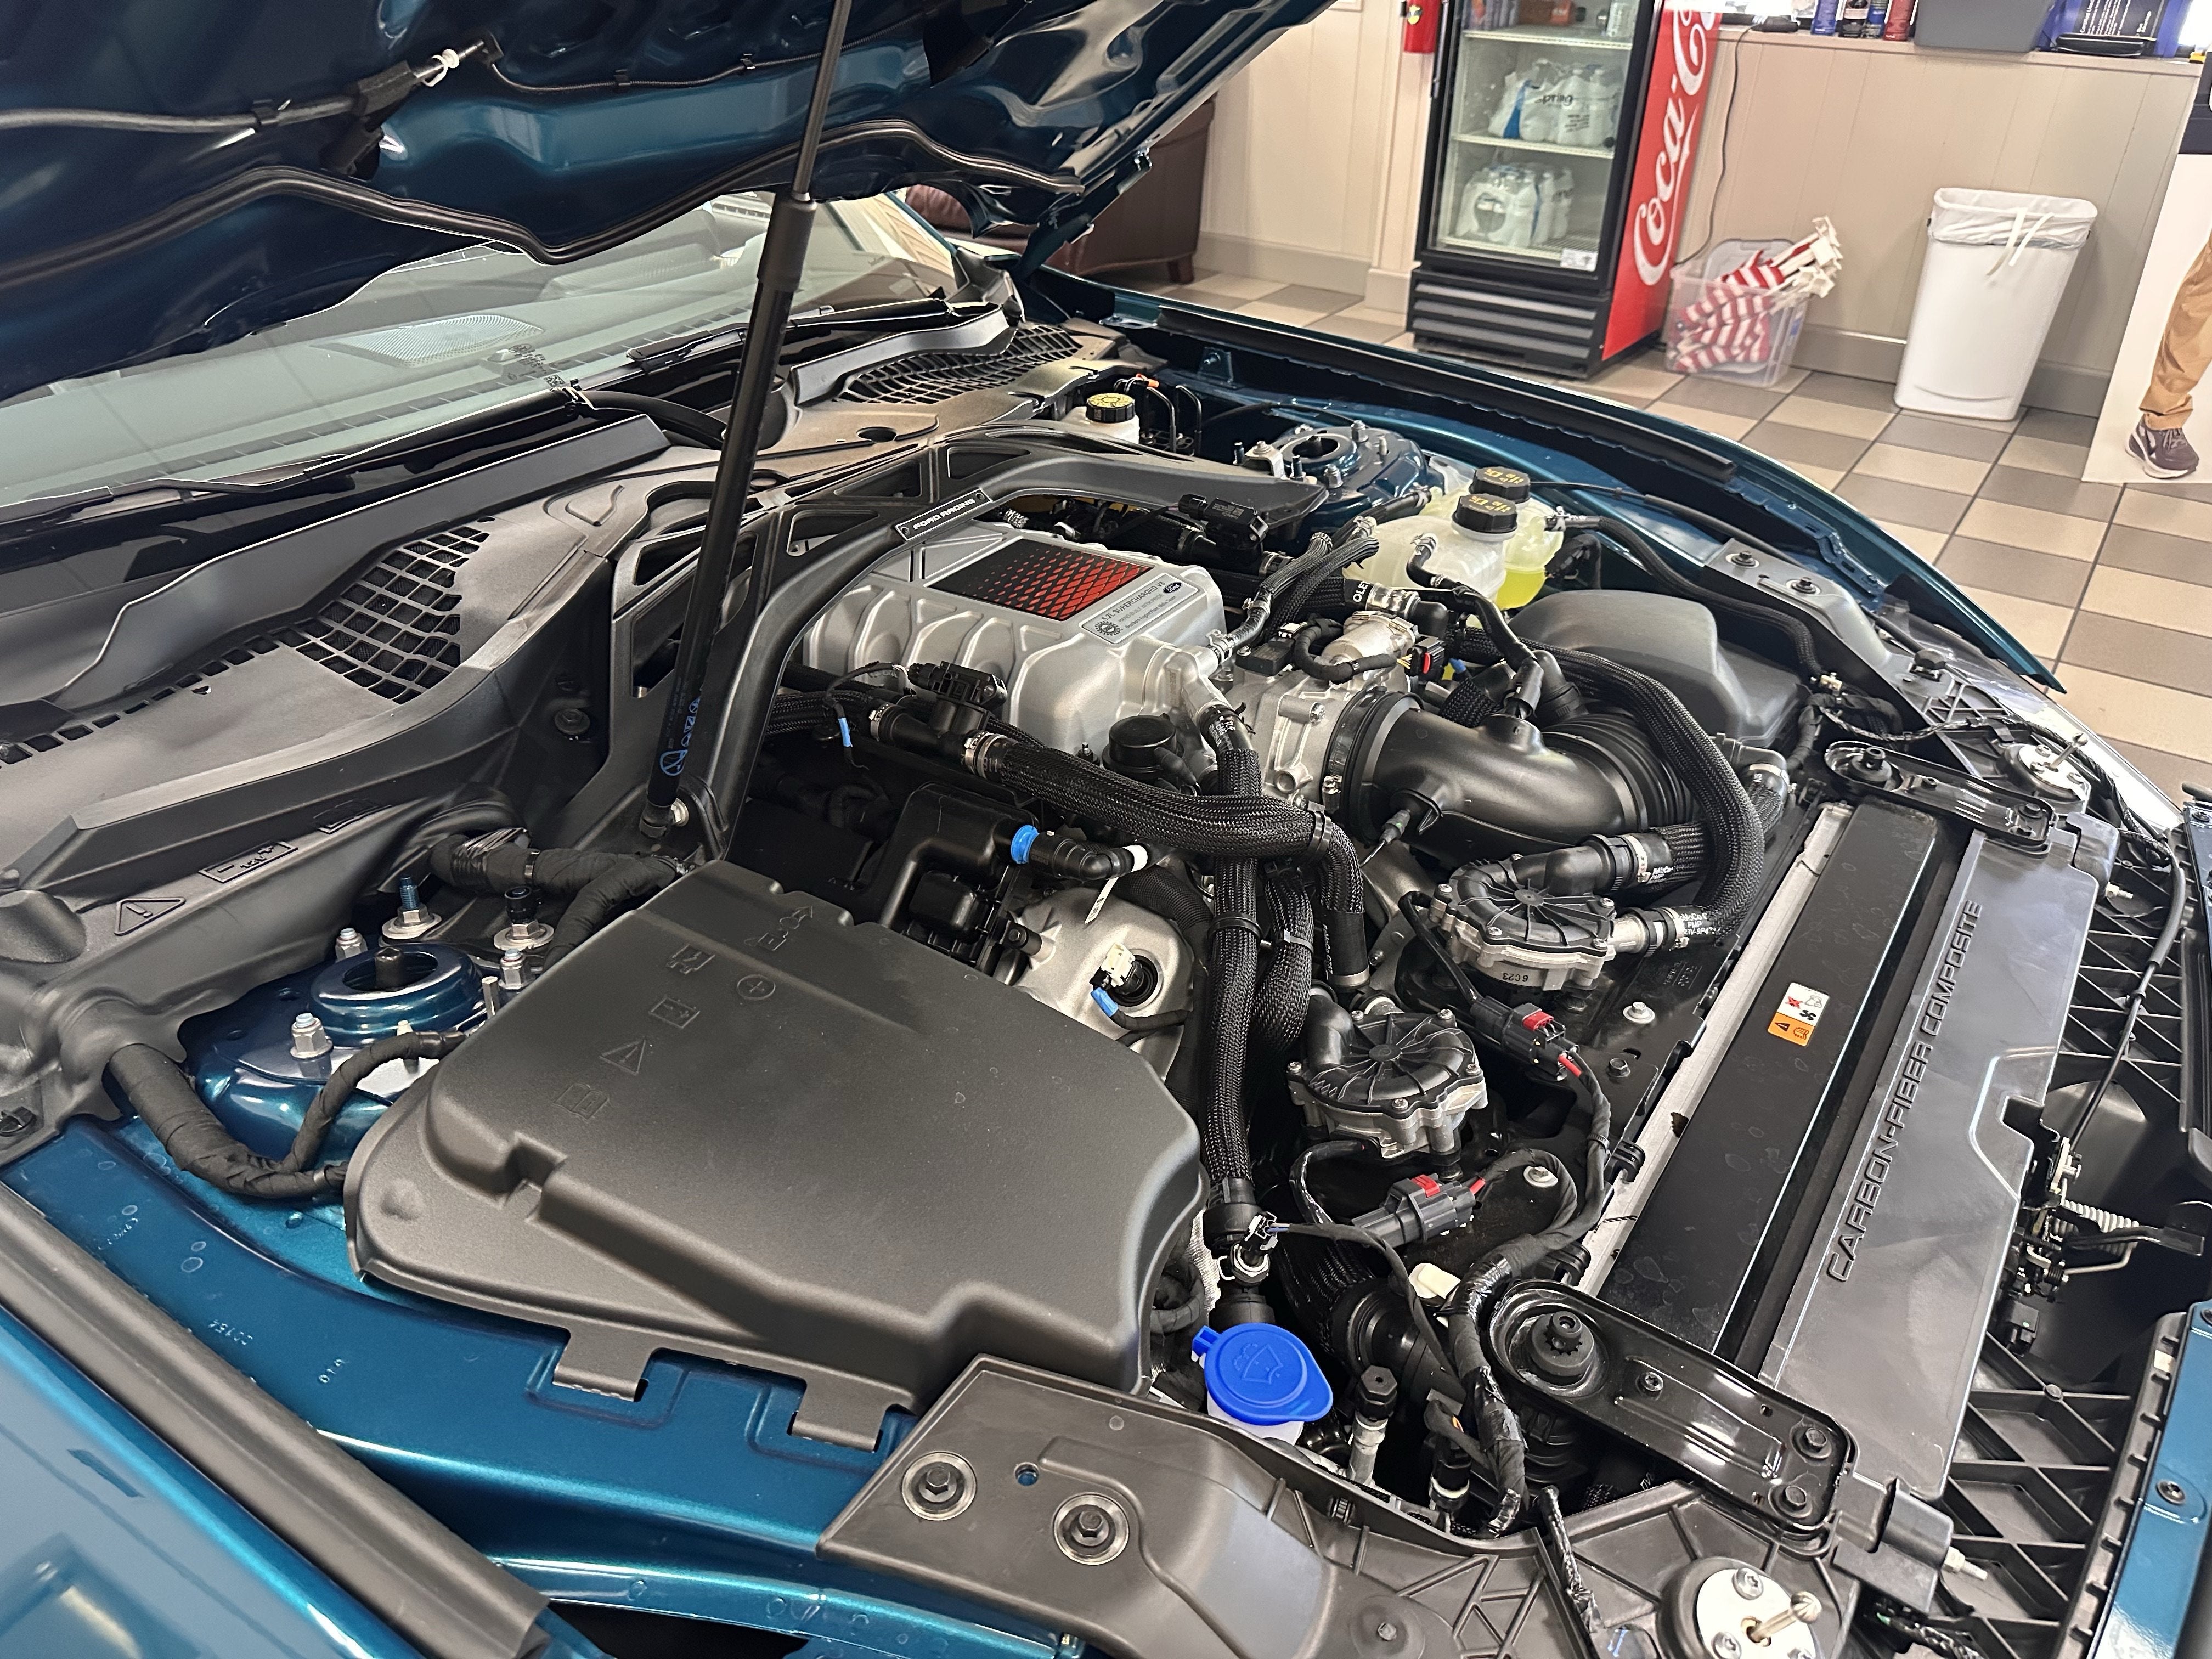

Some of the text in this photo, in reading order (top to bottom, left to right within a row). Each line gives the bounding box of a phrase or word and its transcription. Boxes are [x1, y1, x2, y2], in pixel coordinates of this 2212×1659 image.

[913, 498, 976, 530] FORD RACING
[1101, 581, 1166, 621] 5.2L SUPERCHARGED V8
[1165, 583, 1181, 593] Ford
[1826, 899, 1983, 1282] CARBON-FIBER COMPOSITE
